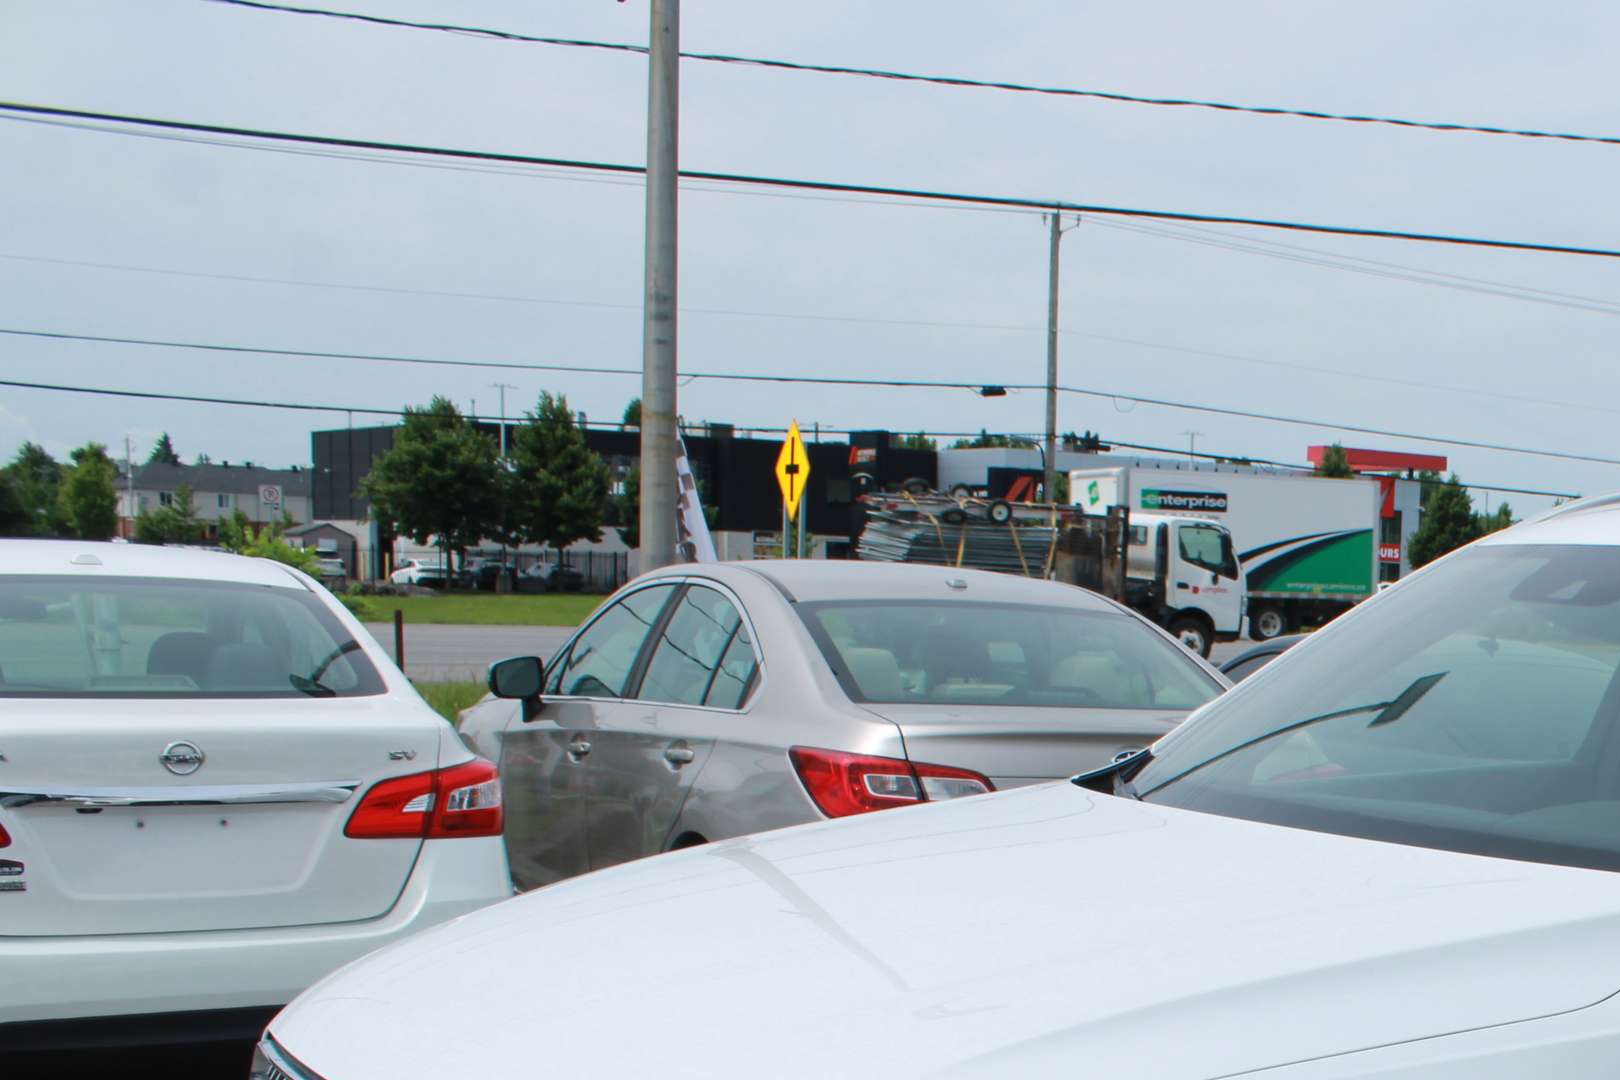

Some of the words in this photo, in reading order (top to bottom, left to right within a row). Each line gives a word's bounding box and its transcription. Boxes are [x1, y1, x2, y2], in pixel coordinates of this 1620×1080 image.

[1146, 495, 1227, 508] enterprise
[1377, 547, 1400, 559] URS
[389, 750, 416, 760] SV
